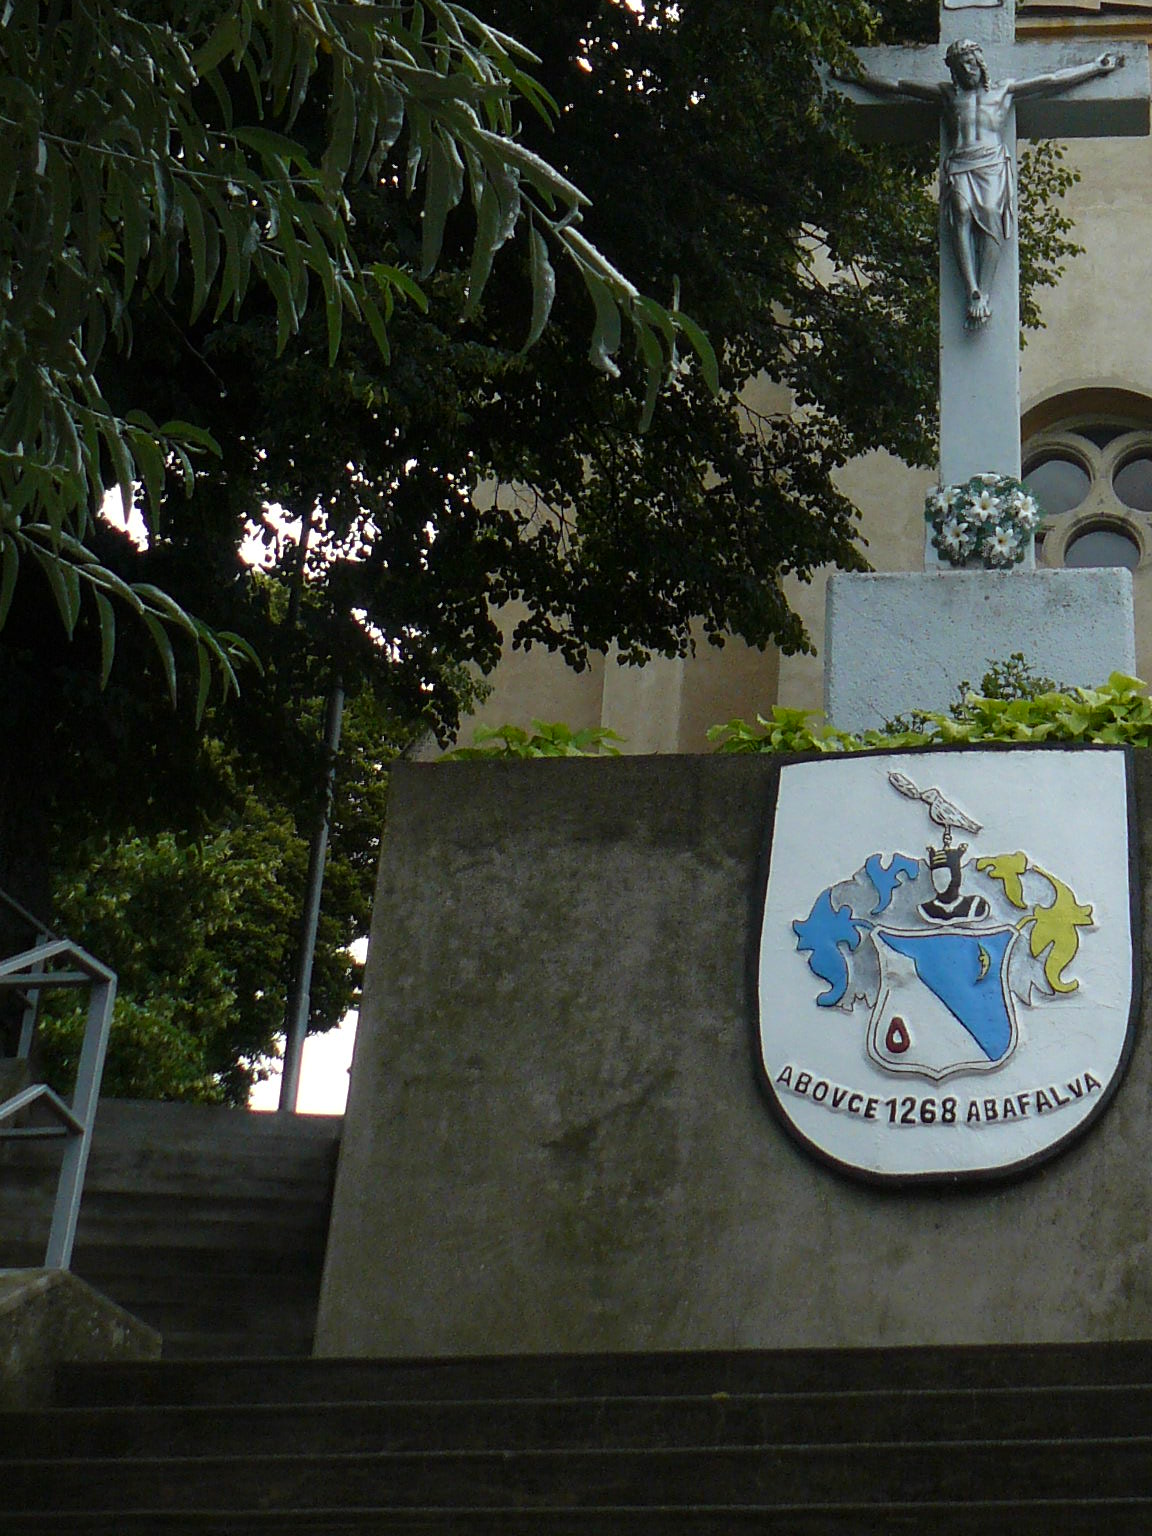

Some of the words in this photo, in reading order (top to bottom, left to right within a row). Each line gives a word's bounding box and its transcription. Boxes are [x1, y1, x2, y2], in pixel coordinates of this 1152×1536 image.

[776, 1066, 879, 1119] ABOVCE
[885, 1096, 957, 1124] 1268
[966, 1072, 1102, 1123] ABAFALVA
